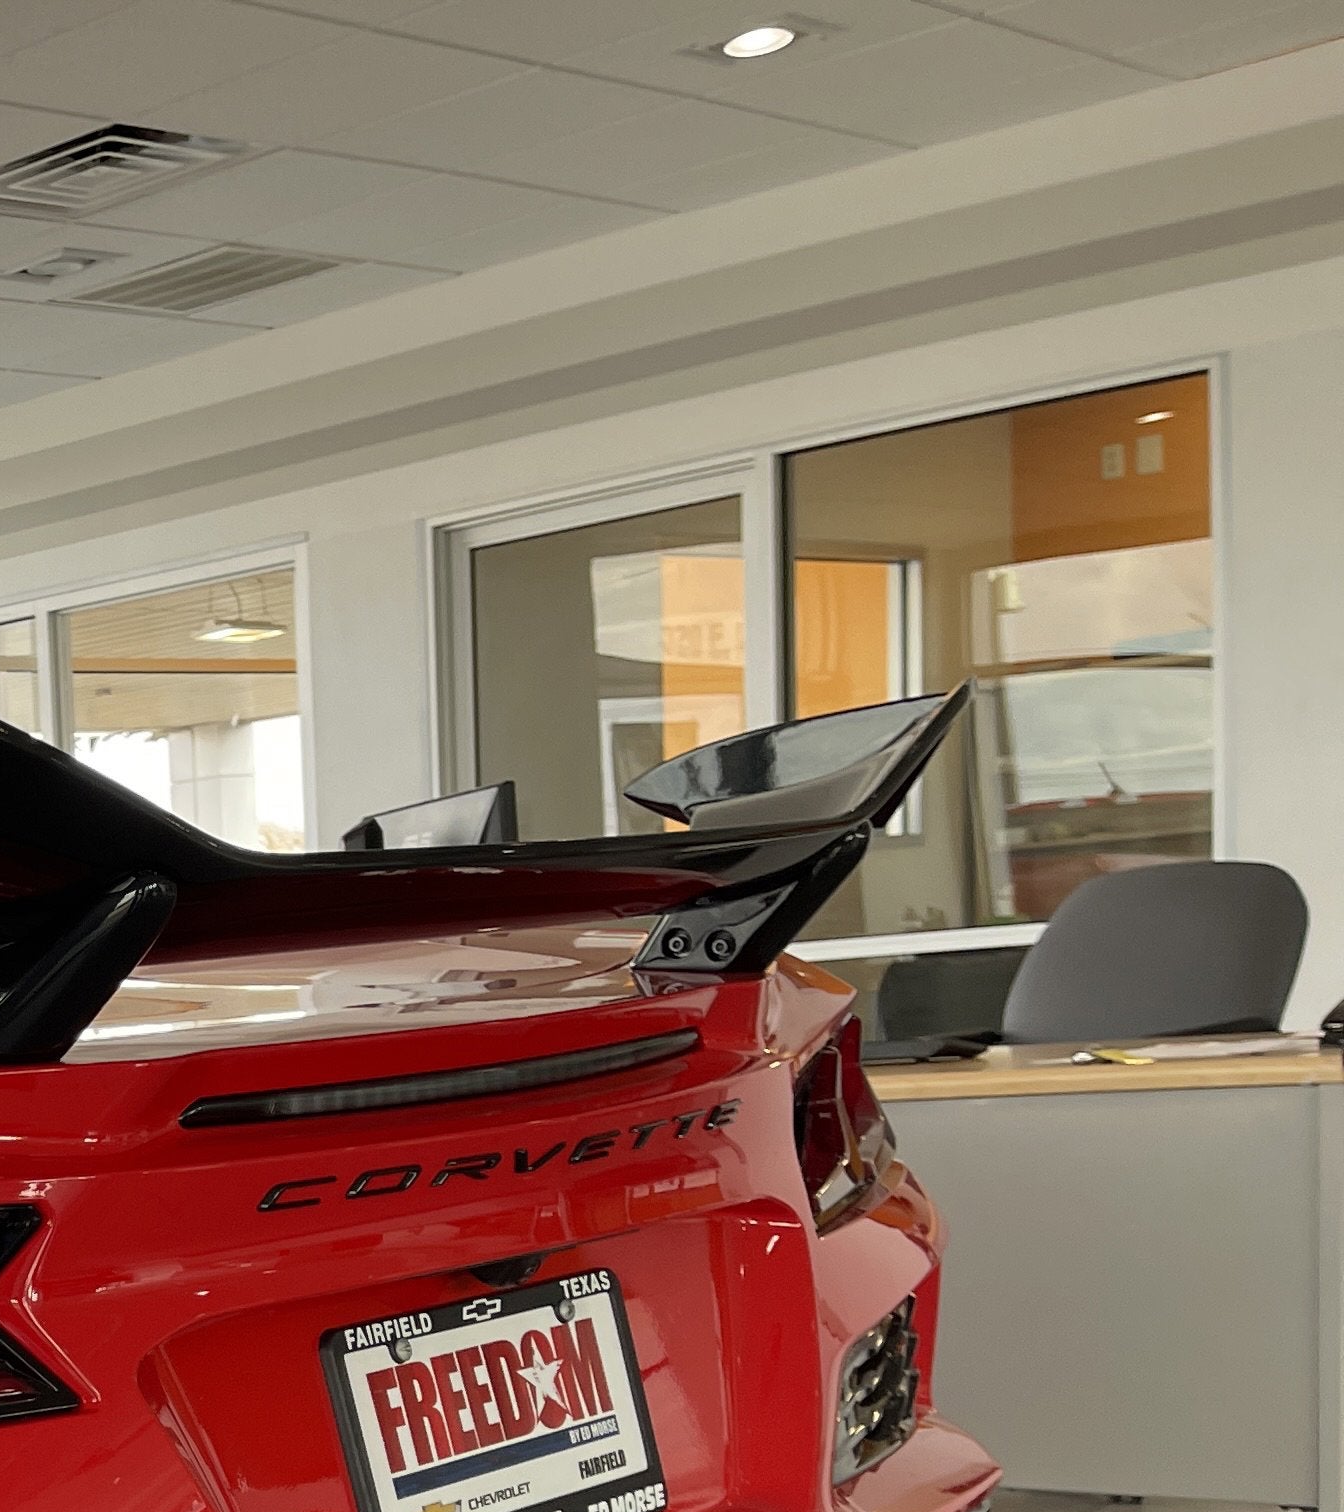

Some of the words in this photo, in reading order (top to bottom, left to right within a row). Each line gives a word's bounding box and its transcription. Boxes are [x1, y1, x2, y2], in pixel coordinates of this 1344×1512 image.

[256, 1098, 743, 1213] CORVETTE
[560, 1271, 611, 1299] TEXAS
[344, 1312, 432, 1350] FAIRFIELD
[366, 1318, 615, 1473] FREEDOM
[569, 1429, 581, 1444] BY
[580, 1425, 592, 1441] ED
[590, 1418, 618, 1438] MORSE
[578, 1449, 627, 1480] FAIRFIELD
[468, 1482, 531, 1510] CHEVROLET
